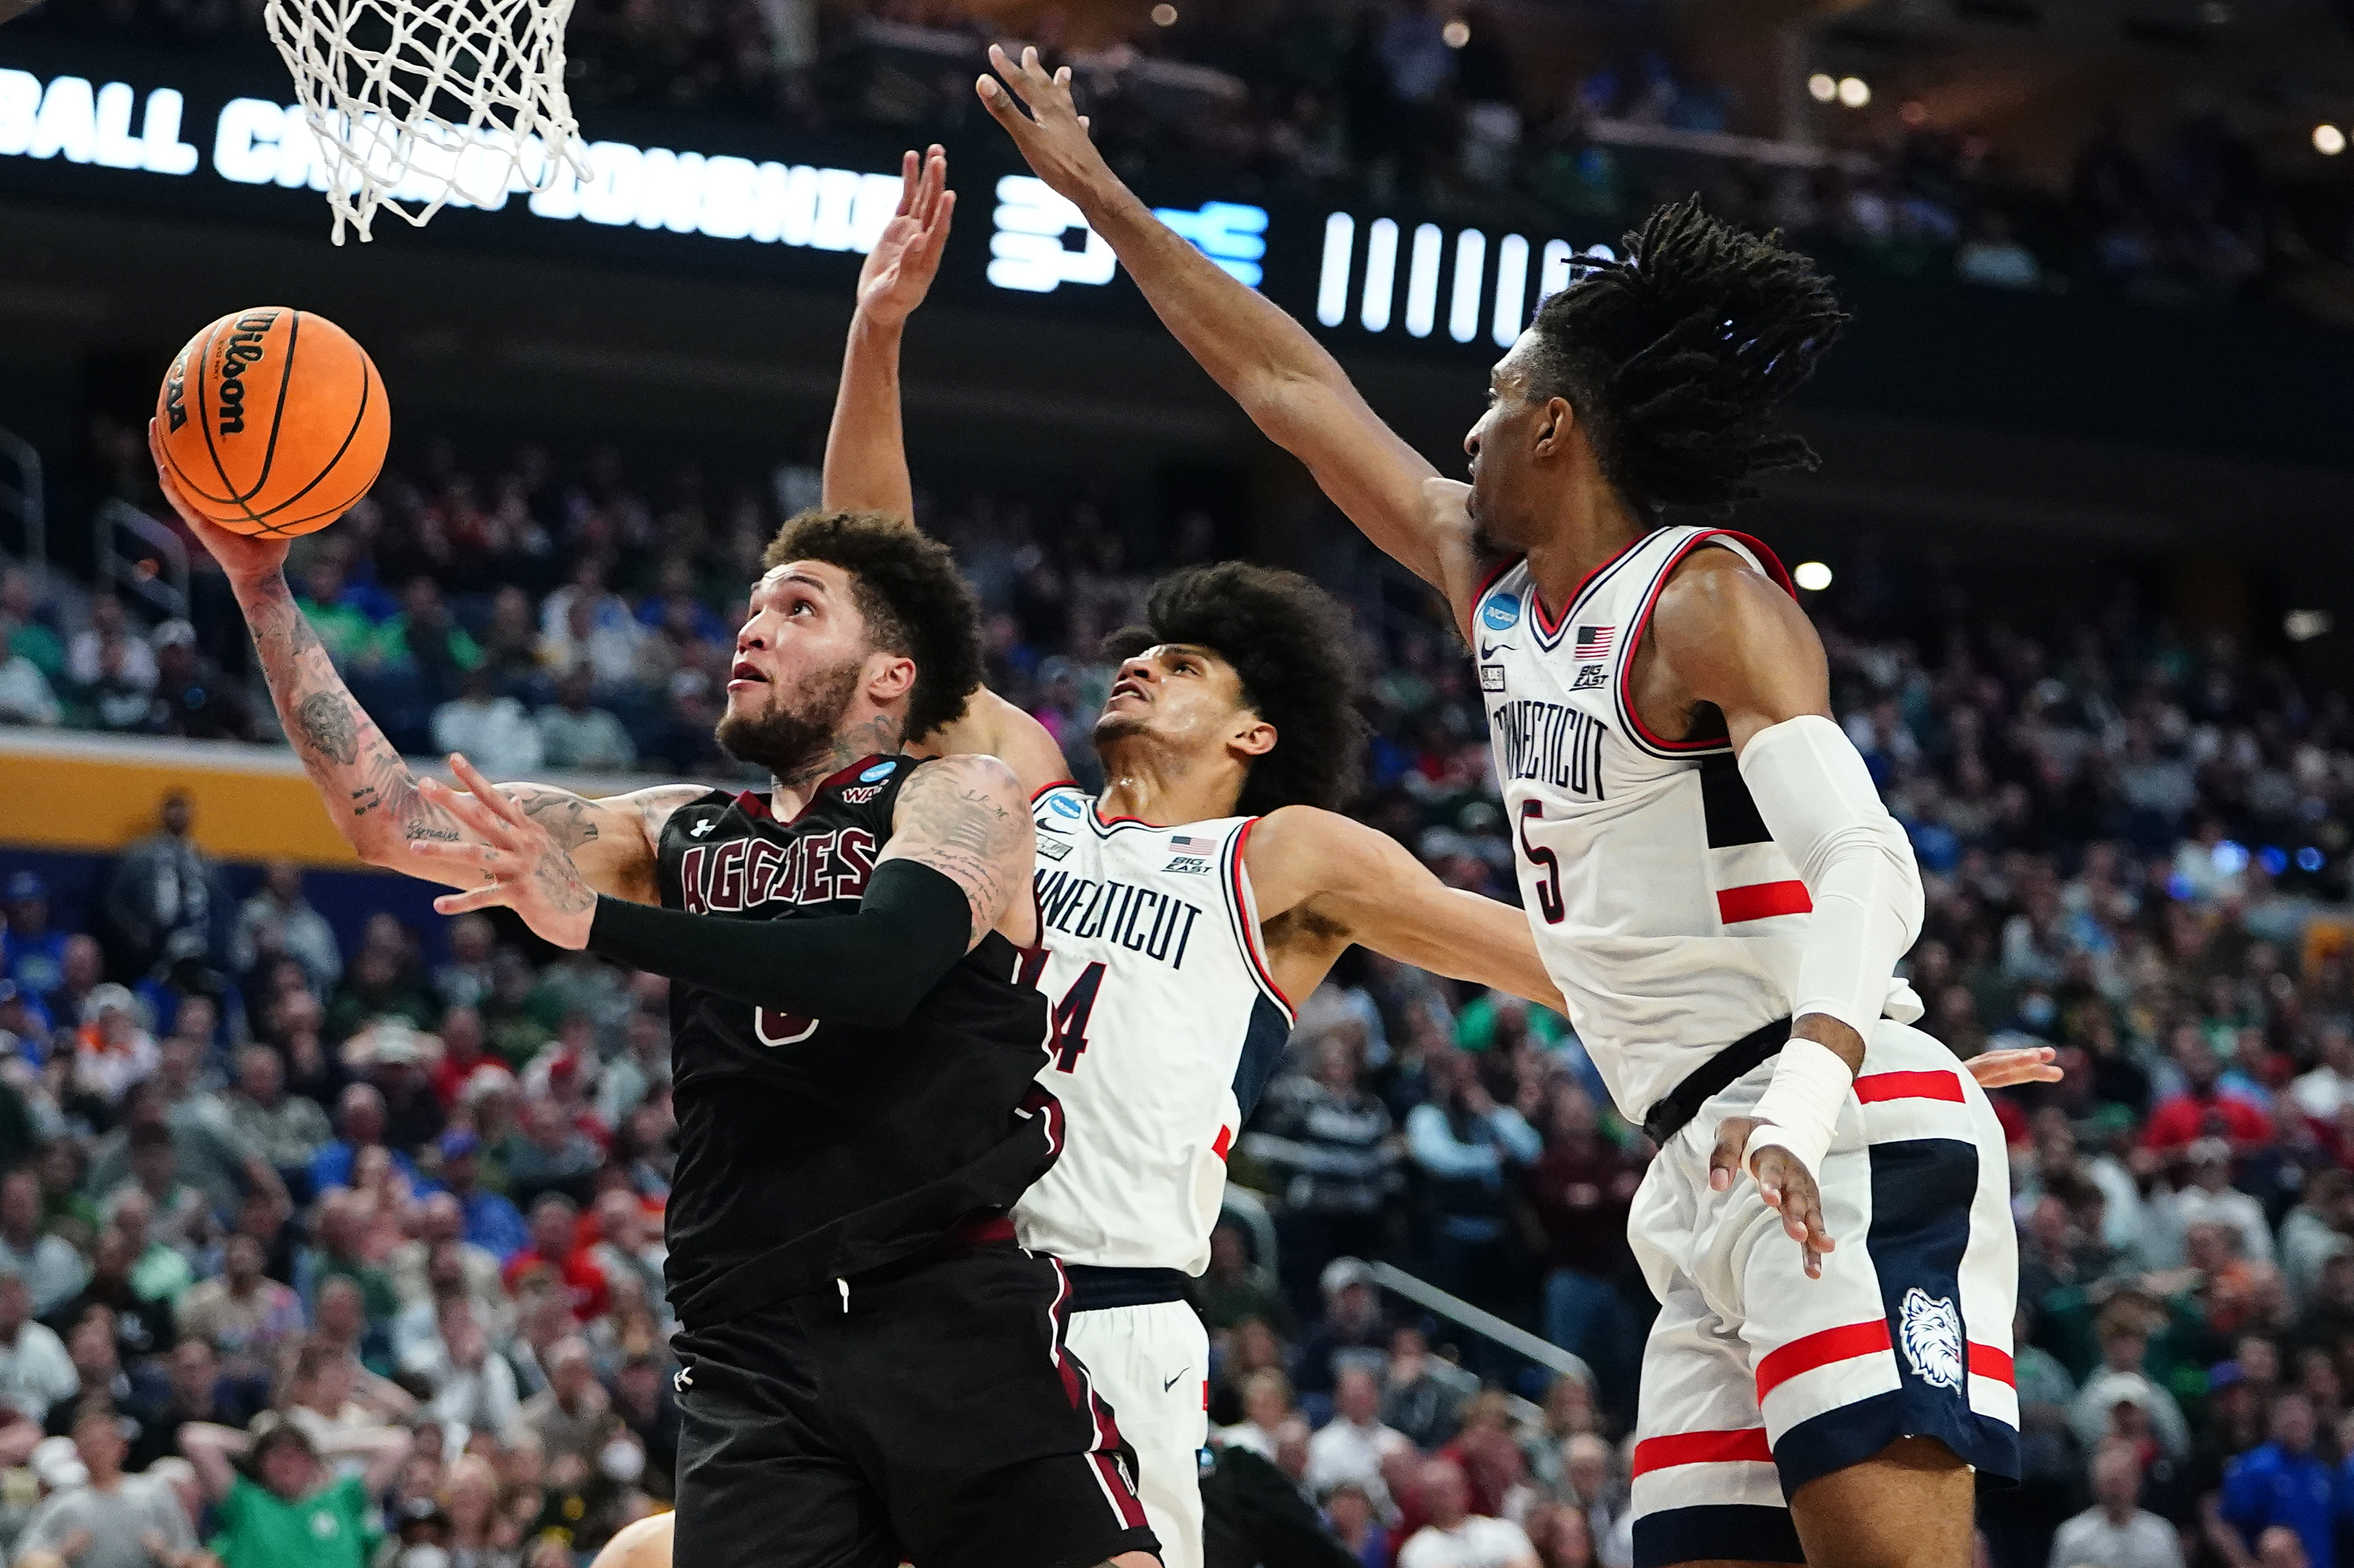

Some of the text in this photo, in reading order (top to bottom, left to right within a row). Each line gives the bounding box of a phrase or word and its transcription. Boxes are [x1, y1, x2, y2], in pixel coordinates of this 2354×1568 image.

[218, 311, 280, 437] Wilson
[1573, 675, 1609, 687] EAST
[681, 827, 877, 916] AGGIES
[1165, 863, 1213, 873] EAST
[1172, 856, 1206, 866] BIG
[1520, 799, 1565, 924] 5
